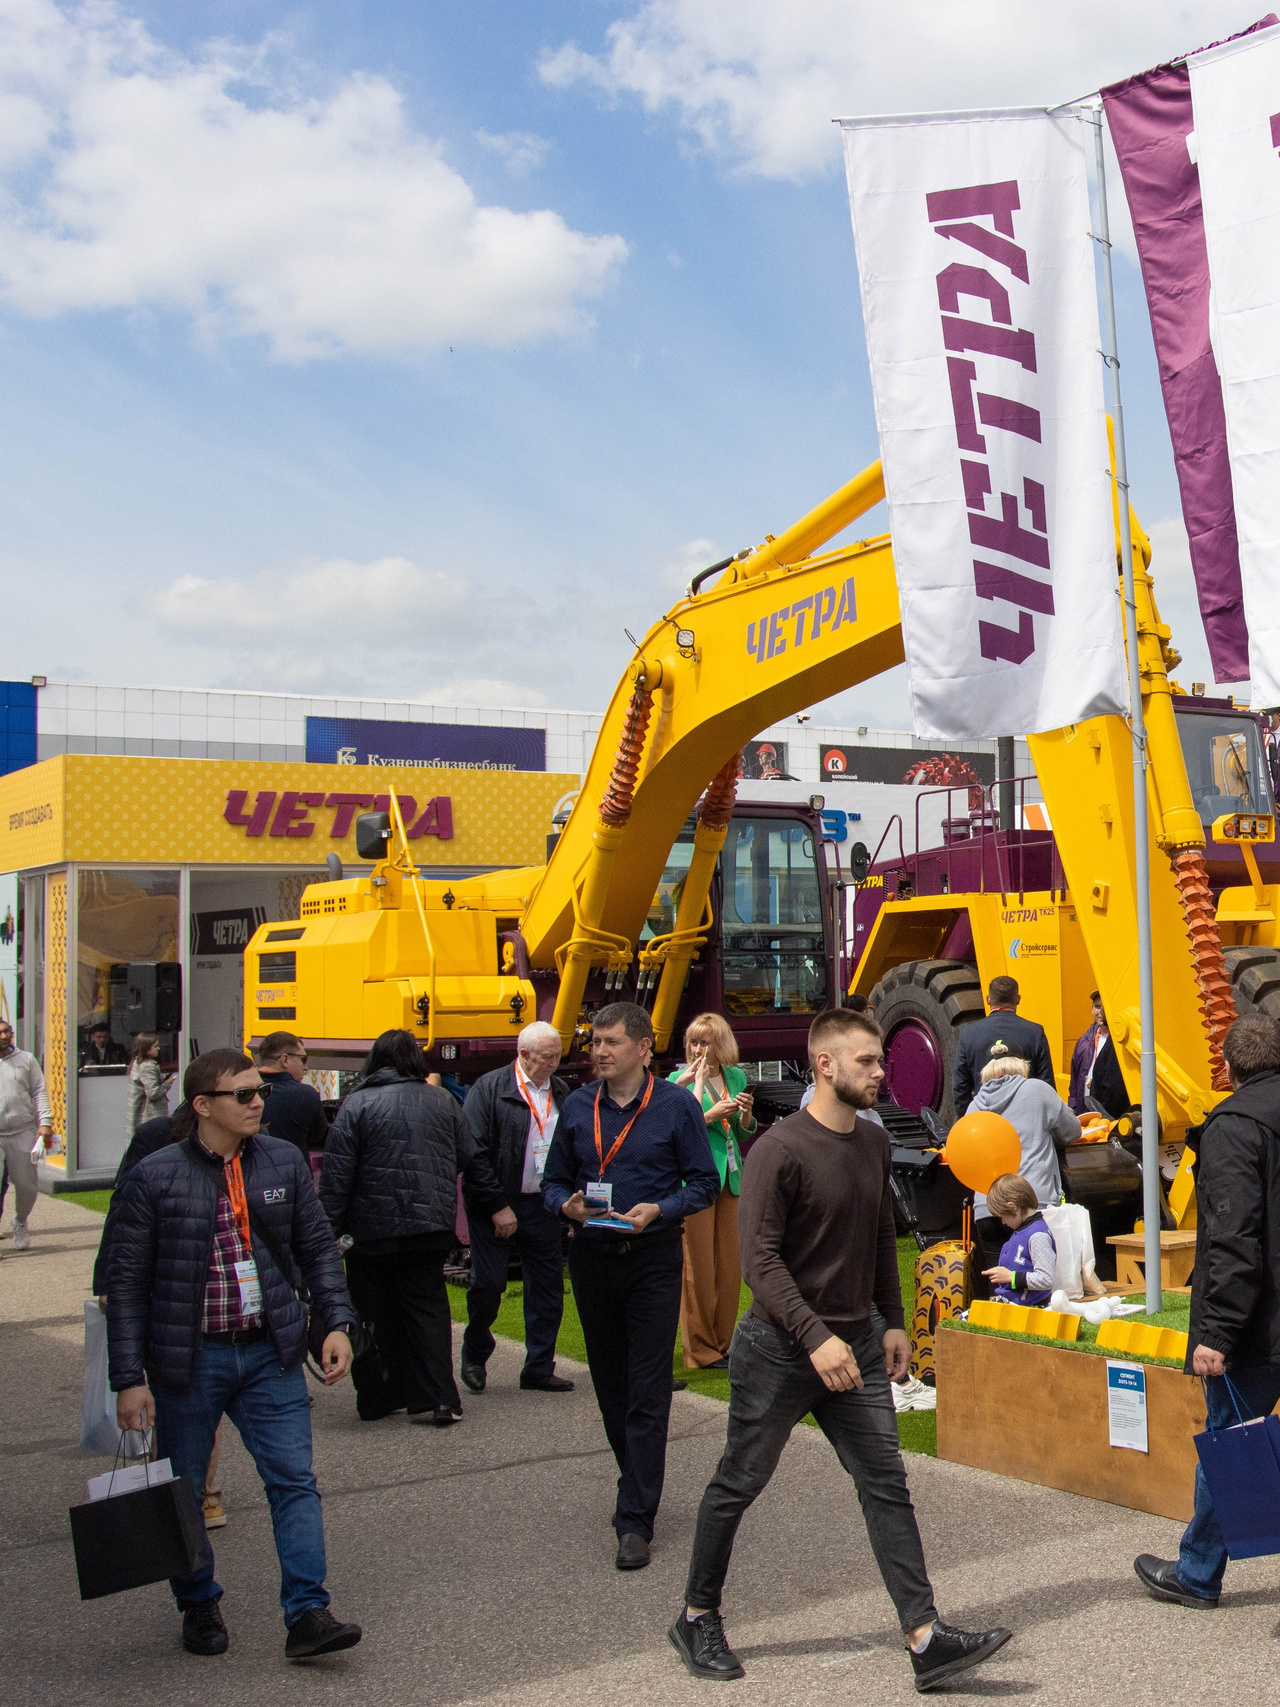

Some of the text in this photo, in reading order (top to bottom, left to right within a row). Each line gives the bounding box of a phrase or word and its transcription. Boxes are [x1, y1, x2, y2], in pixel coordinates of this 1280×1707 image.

[926, 180, 1055, 665] ЧЕТРА
[746, 576, 857, 664] ЧЕТРА
[367, 754, 516, 771] Кузнецкбизнесбанк
[223, 789, 454, 840] ЧЕТРА
[1001, 909, 1038, 923] ЧЕТРА
[213, 918, 249, 946] ЧЕТРА
[1021, 942, 1058, 953] Стройсервис
[263, 1187, 286, 1201] EA7
